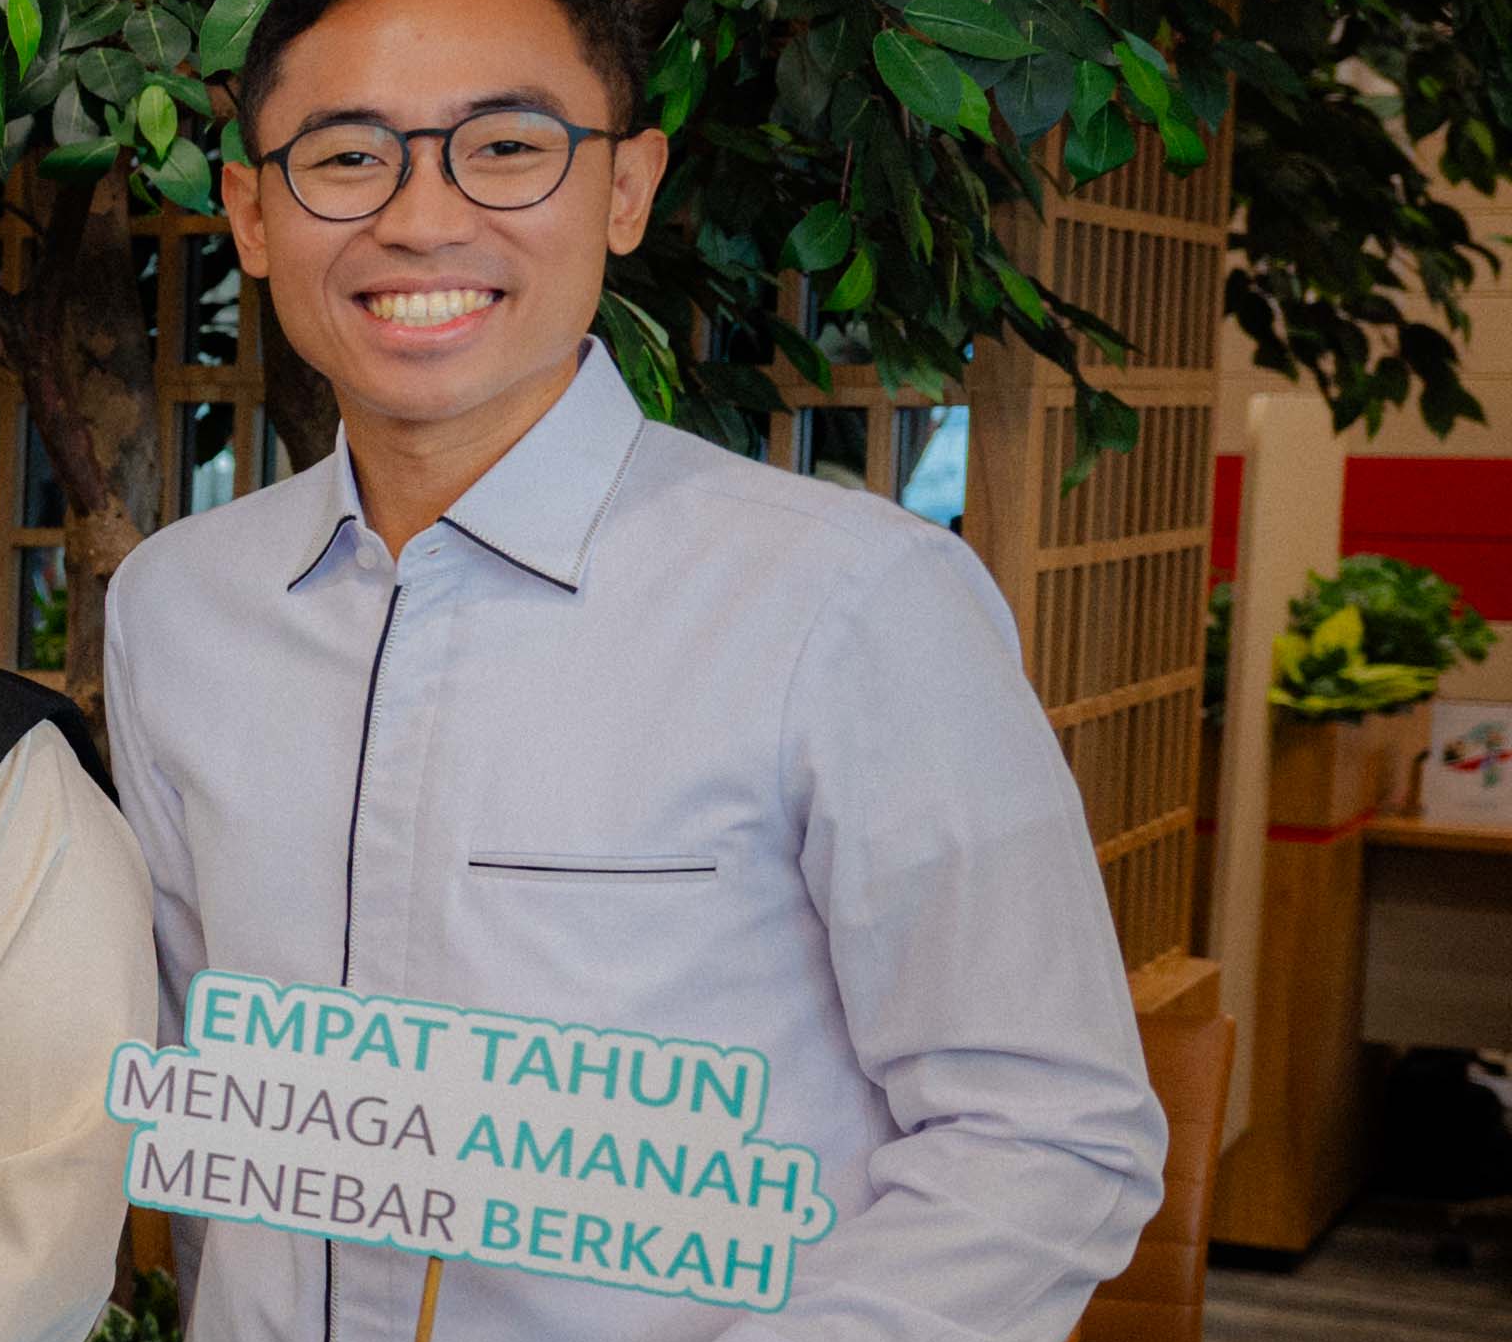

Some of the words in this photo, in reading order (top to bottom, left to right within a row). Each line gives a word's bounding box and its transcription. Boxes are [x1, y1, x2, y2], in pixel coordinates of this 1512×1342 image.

[201, 989, 449, 1072] EMPAT
[471, 1026, 748, 1119] TAHUN
[121, 1058, 437, 1157] MENJAGA
[457, 1114, 815, 1224] AMANAH,
[140, 1142, 457, 1243] MENEBAR
[480, 1199, 774, 1295] BERKAH
